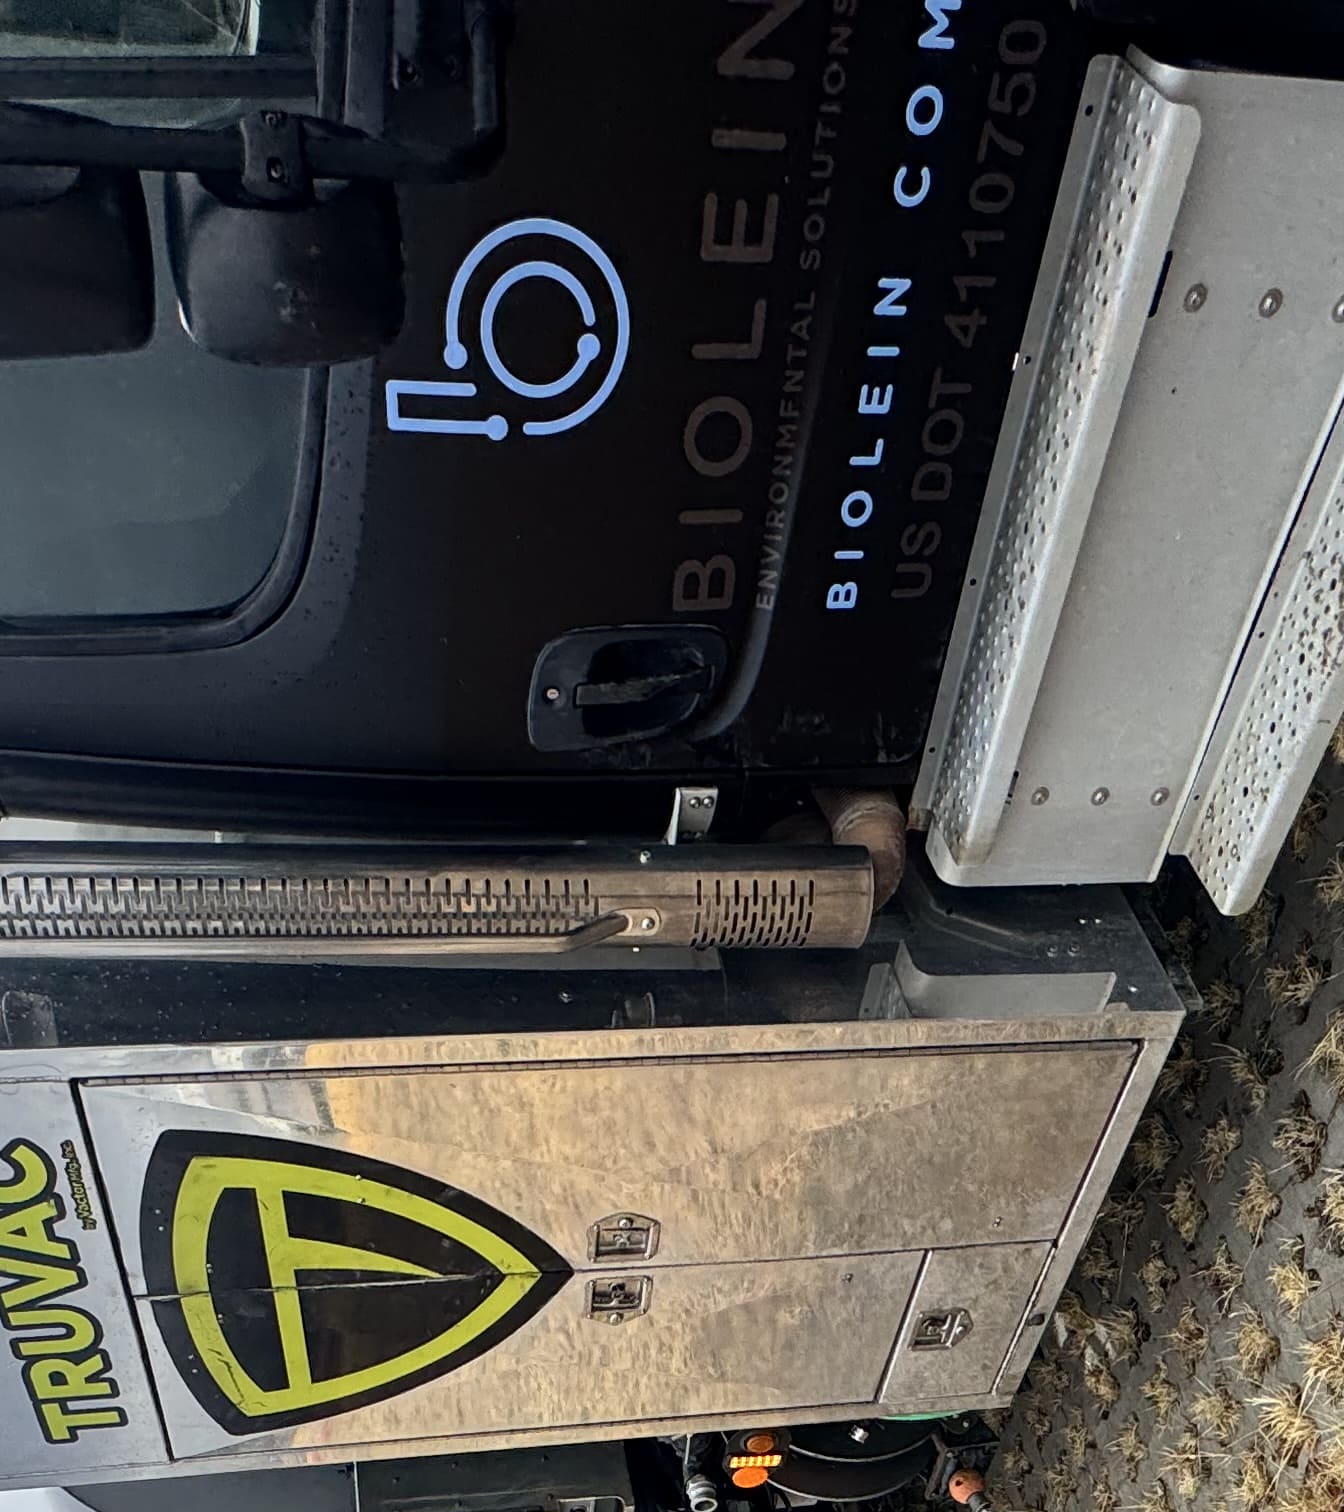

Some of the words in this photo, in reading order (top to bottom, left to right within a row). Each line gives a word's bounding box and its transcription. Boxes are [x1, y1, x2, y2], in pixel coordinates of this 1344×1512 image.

[672, 0, 806, 611] BIOLEIN
[756, 290, 817, 610] ENVIRONMENTAL
[800, 0, 856, 271] SOLUTIONS
[826, 276, 913, 611] BIOLEIN
[893, 0, 964, 208] COM
[945, 18, 1049, 350] 4110750
[891, 519, 943, 600] US
[911, 366, 974, 503] DOT
[71, 1182, 91, 1218] Vactor
